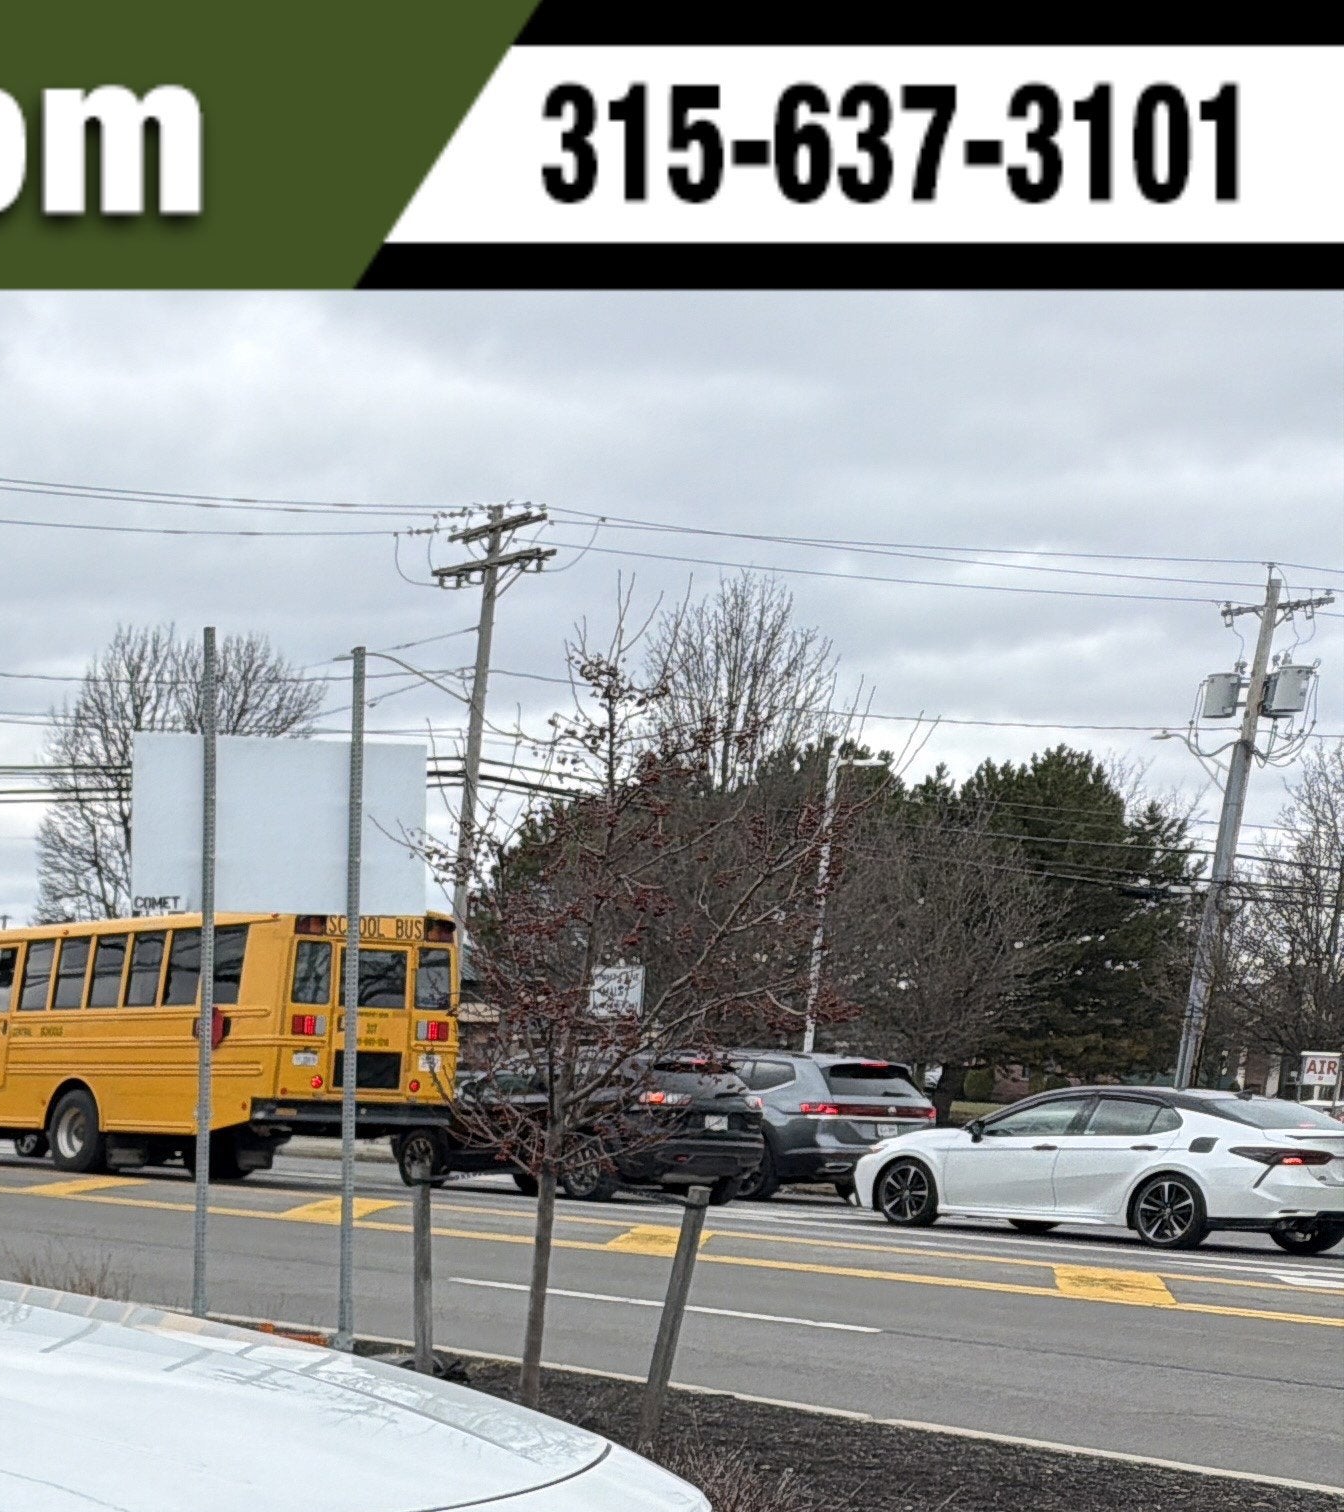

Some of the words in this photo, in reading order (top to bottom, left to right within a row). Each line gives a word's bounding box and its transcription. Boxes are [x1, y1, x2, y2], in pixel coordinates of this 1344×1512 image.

[133, 896, 181, 910] COMET
[328, 914, 386, 939] SCOOL
[395, 918, 423, 940] BUS
[1305, 1059, 1338, 1076] AIR
